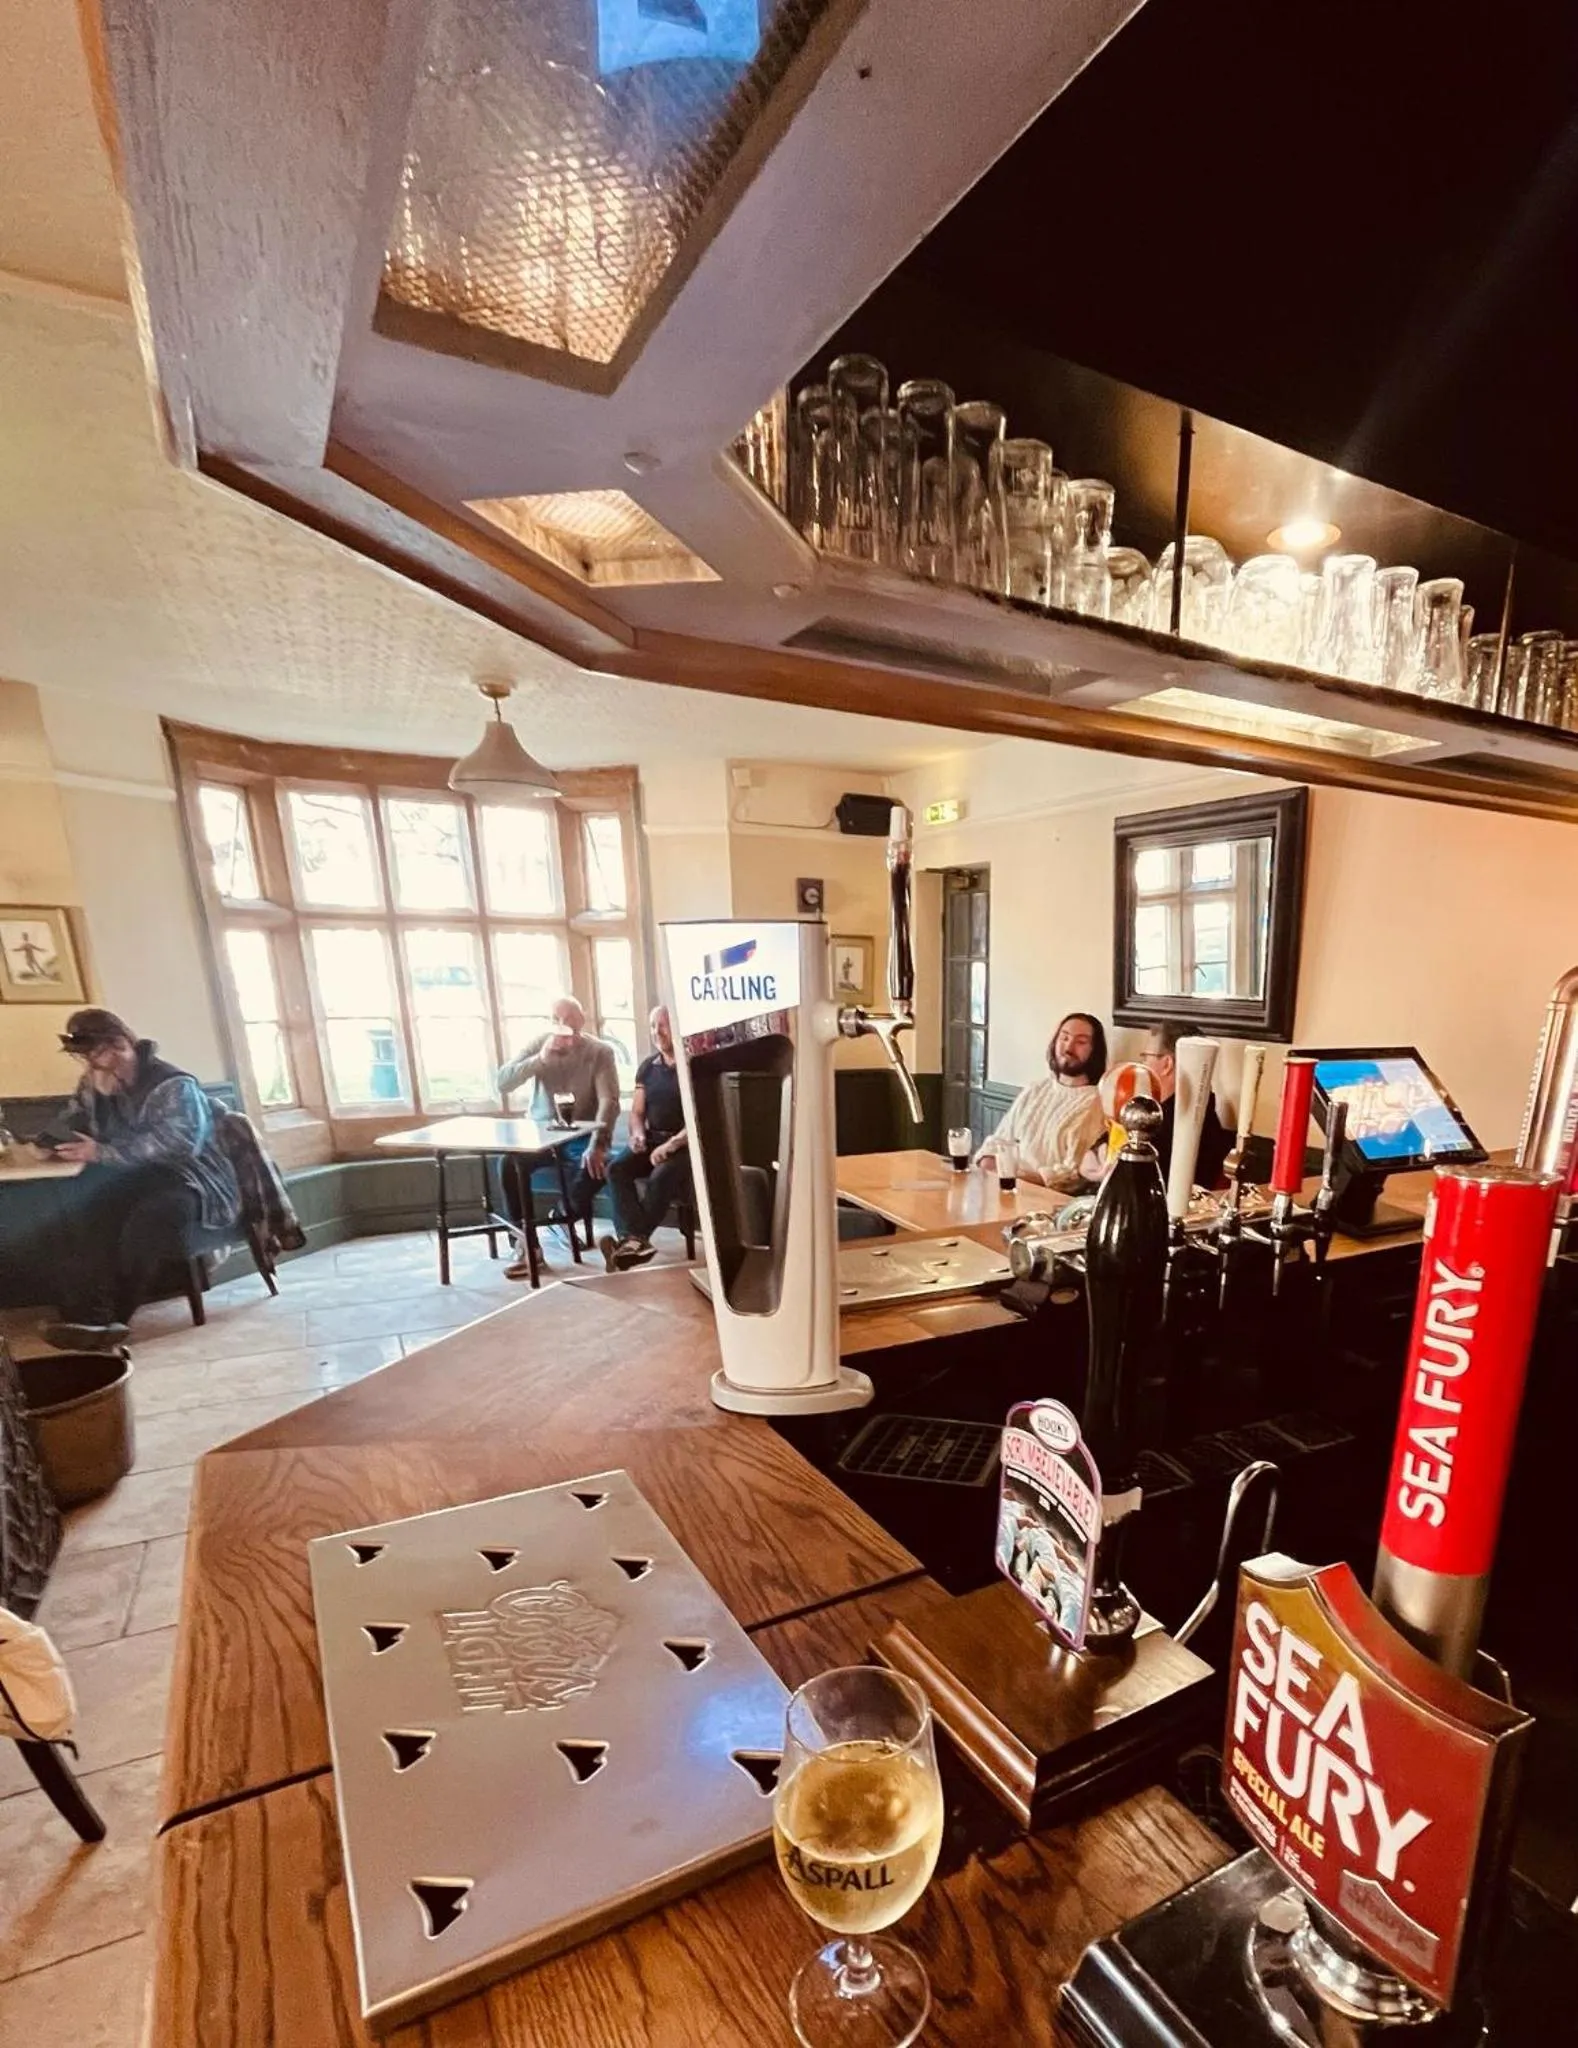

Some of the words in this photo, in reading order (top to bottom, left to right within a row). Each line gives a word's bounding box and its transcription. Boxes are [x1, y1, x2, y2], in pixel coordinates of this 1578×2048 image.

[690, 975, 777, 1001] CARLING
[1037, 1415, 1070, 1438] HOOKY
[1397, 1425, 1458, 1528] SEA
[1242, 1600, 1375, 1777] SEA
[1231, 1746, 1289, 1826] SPECIAL
[1288, 1813, 1326, 1860] ALE
[785, 1845, 895, 1892] ASPALL
